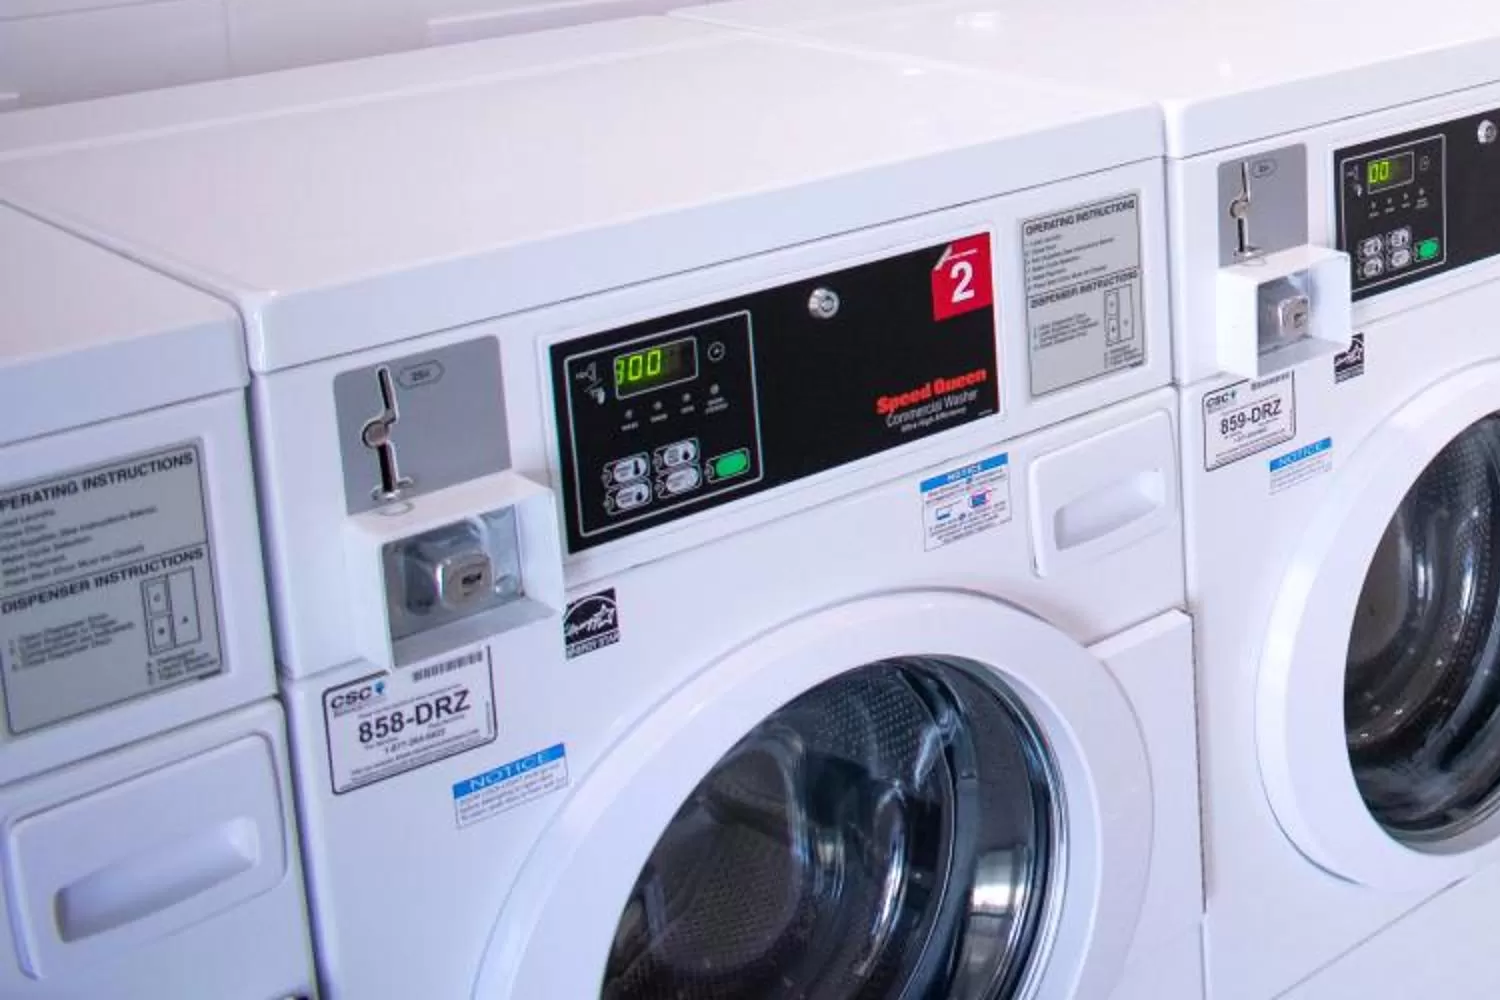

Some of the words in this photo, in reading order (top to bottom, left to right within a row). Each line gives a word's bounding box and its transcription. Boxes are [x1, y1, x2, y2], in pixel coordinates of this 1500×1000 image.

[950, 260, 975, 303] 2
[876, 381, 932, 415] Speed
[933, 368, 987, 396] Queen
[1220, 398, 1283, 436] 859-DRZ
[82, 451, 194, 491] INSTRUCTIONS
[1, 579, 90, 614] DISPENSER
[94, 548, 203, 589] INSTRUCTIONS
[331, 686, 372, 710] CSC
[358, 688, 472, 743] 858-DRZ
[469, 751, 549, 792] NOTICE
